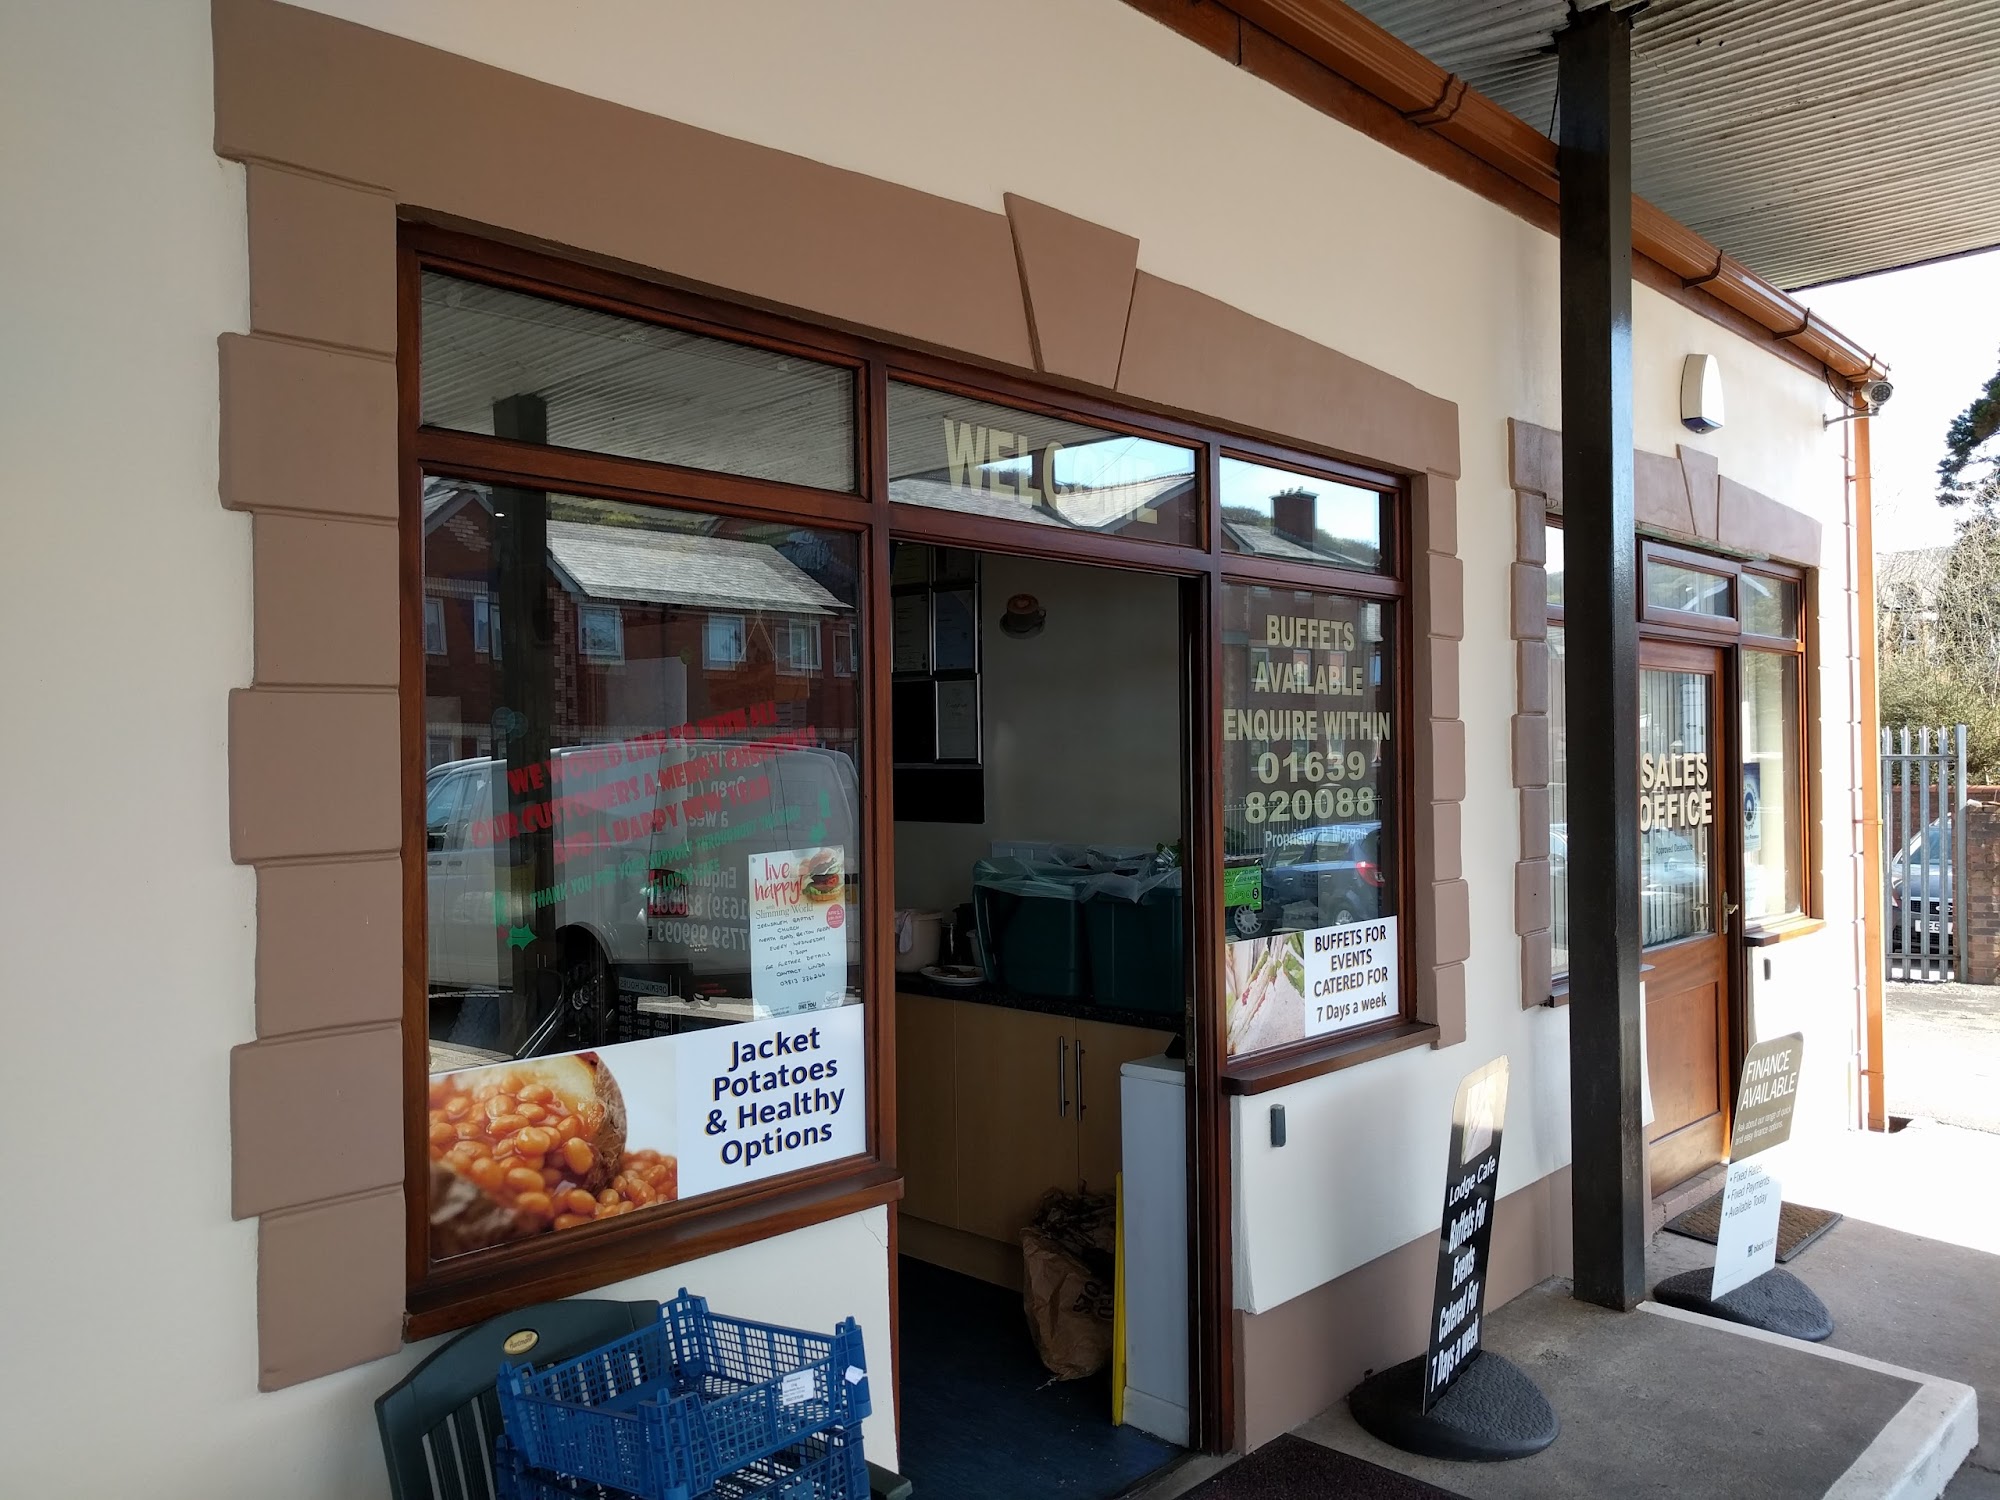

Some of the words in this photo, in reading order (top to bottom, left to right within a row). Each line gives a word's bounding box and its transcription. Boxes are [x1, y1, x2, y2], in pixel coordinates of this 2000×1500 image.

[1267, 614, 1355, 652] BUFFETS
[1254, 661, 1364, 696] AVAILABLE
[1223, 709, 1318, 743] ENQUIRE
[1323, 711, 1391, 741] WITHIN
[505, 763, 544, 795] WE
[543, 743, 623, 785] WOULD
[623, 729, 669, 763] LIKE
[1257, 751, 1366, 784] 01639
[1641, 752, 1708, 789] SALES
[471, 811, 520, 848] OUR
[521, 776, 641, 833] CUSTOMERS
[642, 770, 657, 798] A
[1245, 787, 1375, 824] 820088
[1640, 791, 1713, 832] OFFICE
[597, 822, 613, 852] A
[611, 802, 679, 845] HAPPY
[1265, 829, 1315, 850] Proprietor
[765, 857, 790, 881] live
[529, 881, 569, 911] THANK
[570, 875, 594, 897] YOU
[754, 875, 804, 907] happy!
[755, 907, 790, 920] Slimming
[791, 902, 814, 914] World
[757, 920, 788, 930] JERUSALEM
[792, 915, 815, 924] BAPTIST
[758, 935, 777, 943] NEATH
[769, 943, 788, 951] EVERY
[793, 936, 826, 946] WEDNESDAY
[776, 925, 800, 933] CHURCH
[1315, 929, 1362, 952] BUFFETS
[1365, 925, 1387, 943] FOR
[776, 968, 802, 977] CONTACT
[808, 962, 826, 971] LINDA
[806, 952, 831, 961] DETAILS
[1331, 948, 1372, 972] EVENTS
[1314, 972, 1364, 998] CATERED
[1367, 966, 1388, 986] FOR
[1316, 1006, 1323, 1023] 7
[1326, 1003, 1350, 1022] Days
[1353, 1001, 1359, 1014] a
[1361, 991, 1387, 1012] week
[727, 1027, 821, 1072] Jacket
[1745, 1049, 1792, 1084] FINANCE
[713, 1059, 838, 1101] Potatoes
[1740, 1071, 1797, 1111] AVAILABLE
[705, 1108, 727, 1135] &
[738, 1087, 845, 1129] Healthy
[1737, 1123, 1745, 1133] Ask
[1745, 1118, 1757, 1130] about
[1757, 1117, 1765, 1126] our
[1776, 1107, 1782, 1118] of
[720, 1123, 833, 1167] Options
[1734, 1135, 1744, 1146] and
[1743, 1132, 1753, 1143] easy
[1753, 1127, 1769, 1138] finance
[1449, 1174, 1476, 1207] Lodge
[1477, 1155, 1496, 1184] Cafe
[1730, 1185, 1746, 1201] Fixed
[1745, 1174, 1771, 1195] Payments
[1733, 1167, 1748, 1184] Fixed
[1748, 1164, 1763, 1178] Rates
[1728, 1199, 1752, 1219] Available
[1753, 1193, 1769, 1208] Today
[1448, 1206, 1476, 1255] Buffets
[1474, 1197, 1487, 1232] For
[1451, 1244, 1475, 1291] Events
[1438, 1285, 1468, 1343] Catered
[1467, 1279, 1479, 1314] For
[1431, 1355, 1438, 1393] 7
[1437, 1343, 1455, 1384] Days
[1455, 1338, 1461, 1366] a
[1461, 1312, 1479, 1359] week
